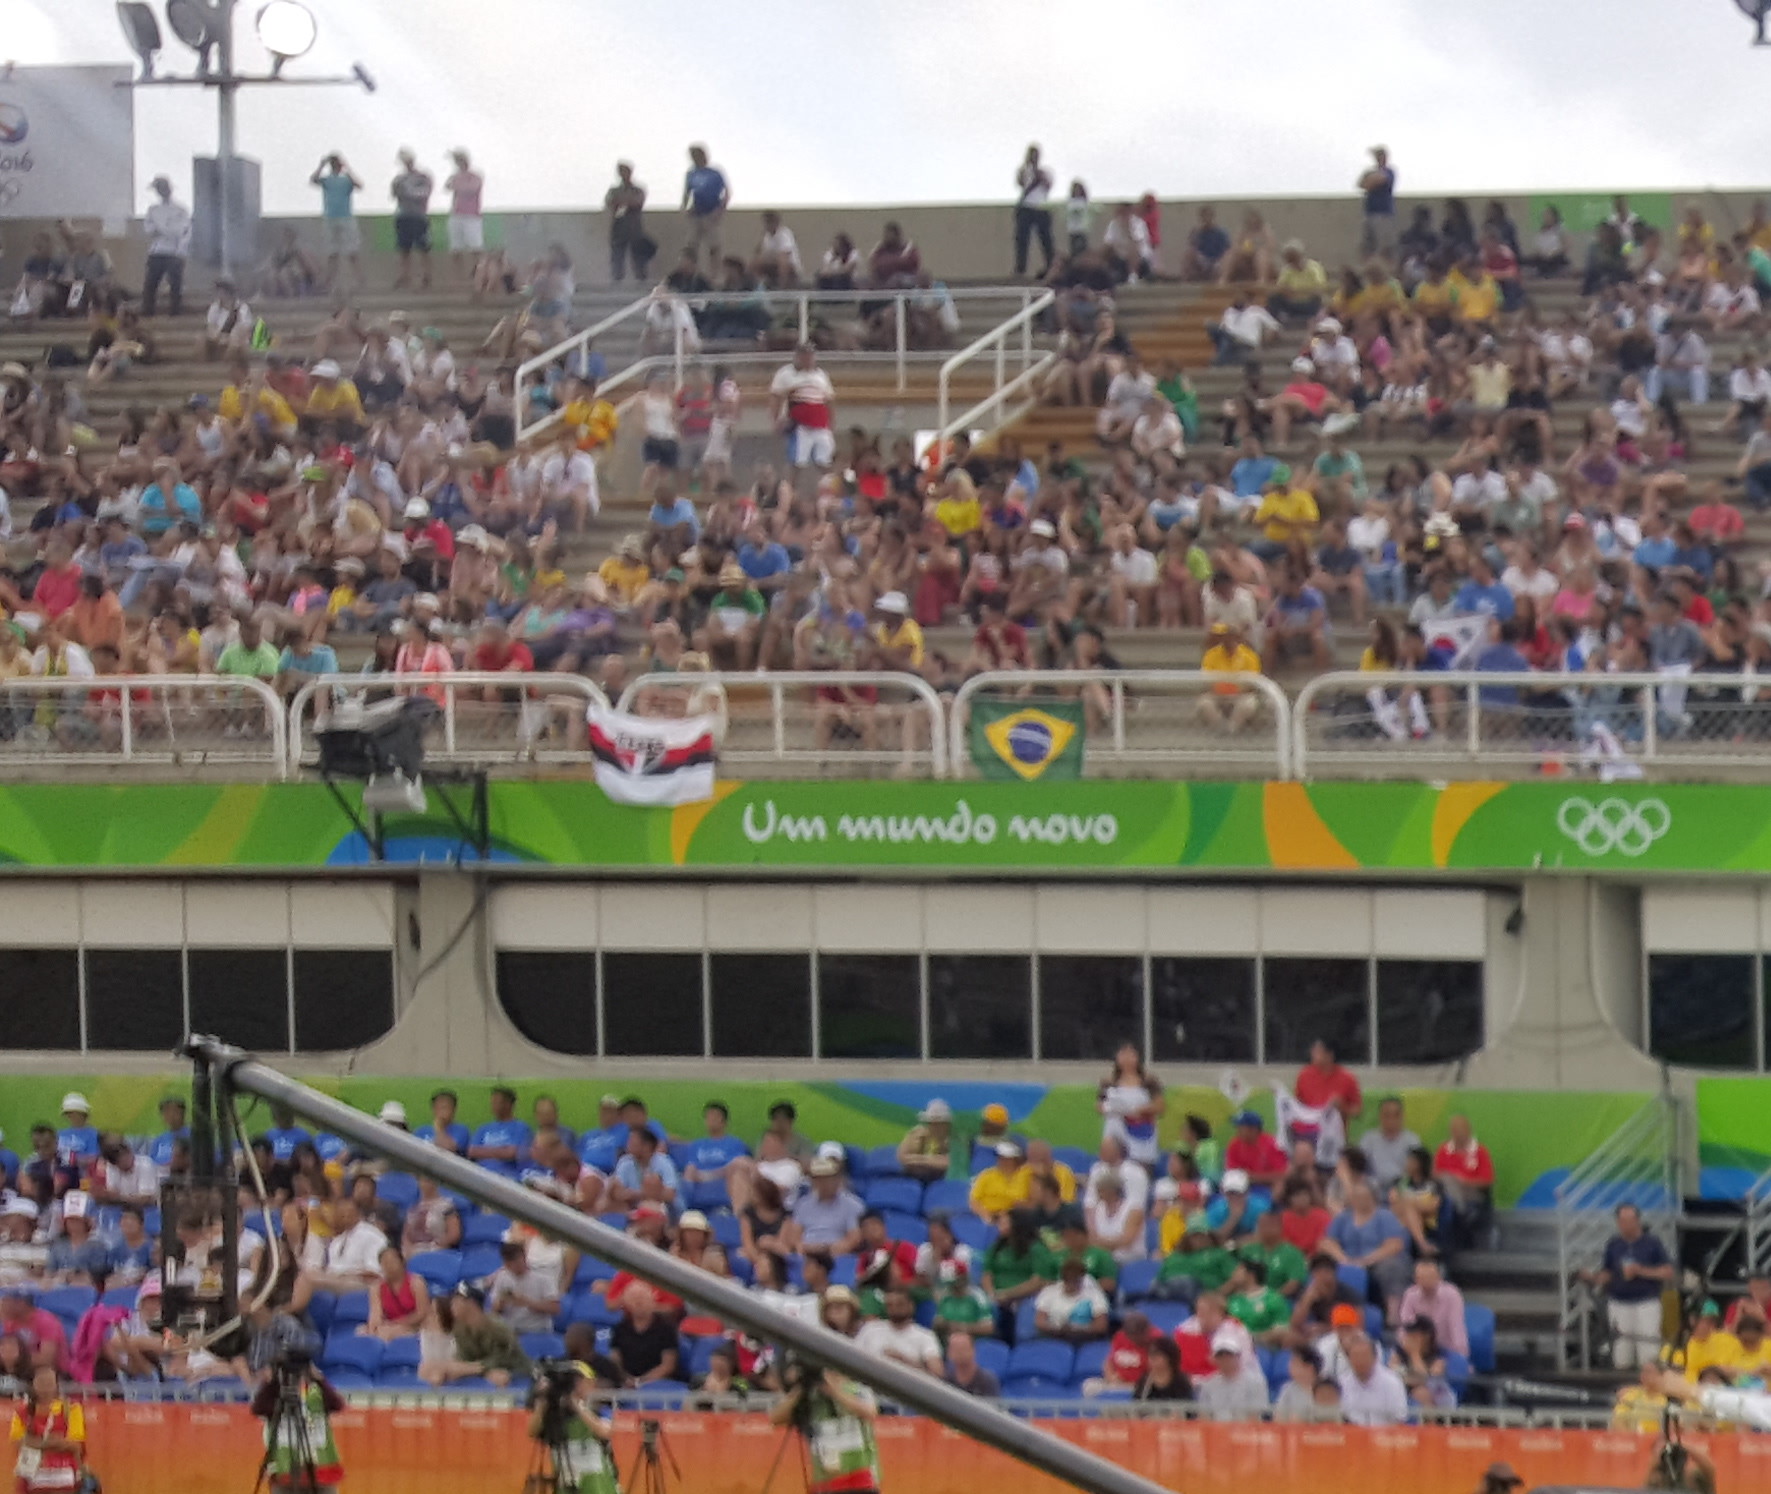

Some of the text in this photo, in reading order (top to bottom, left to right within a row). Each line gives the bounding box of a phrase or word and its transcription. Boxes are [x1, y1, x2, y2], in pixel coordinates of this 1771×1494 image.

[742, 800, 1120, 844] Um mundo novo
